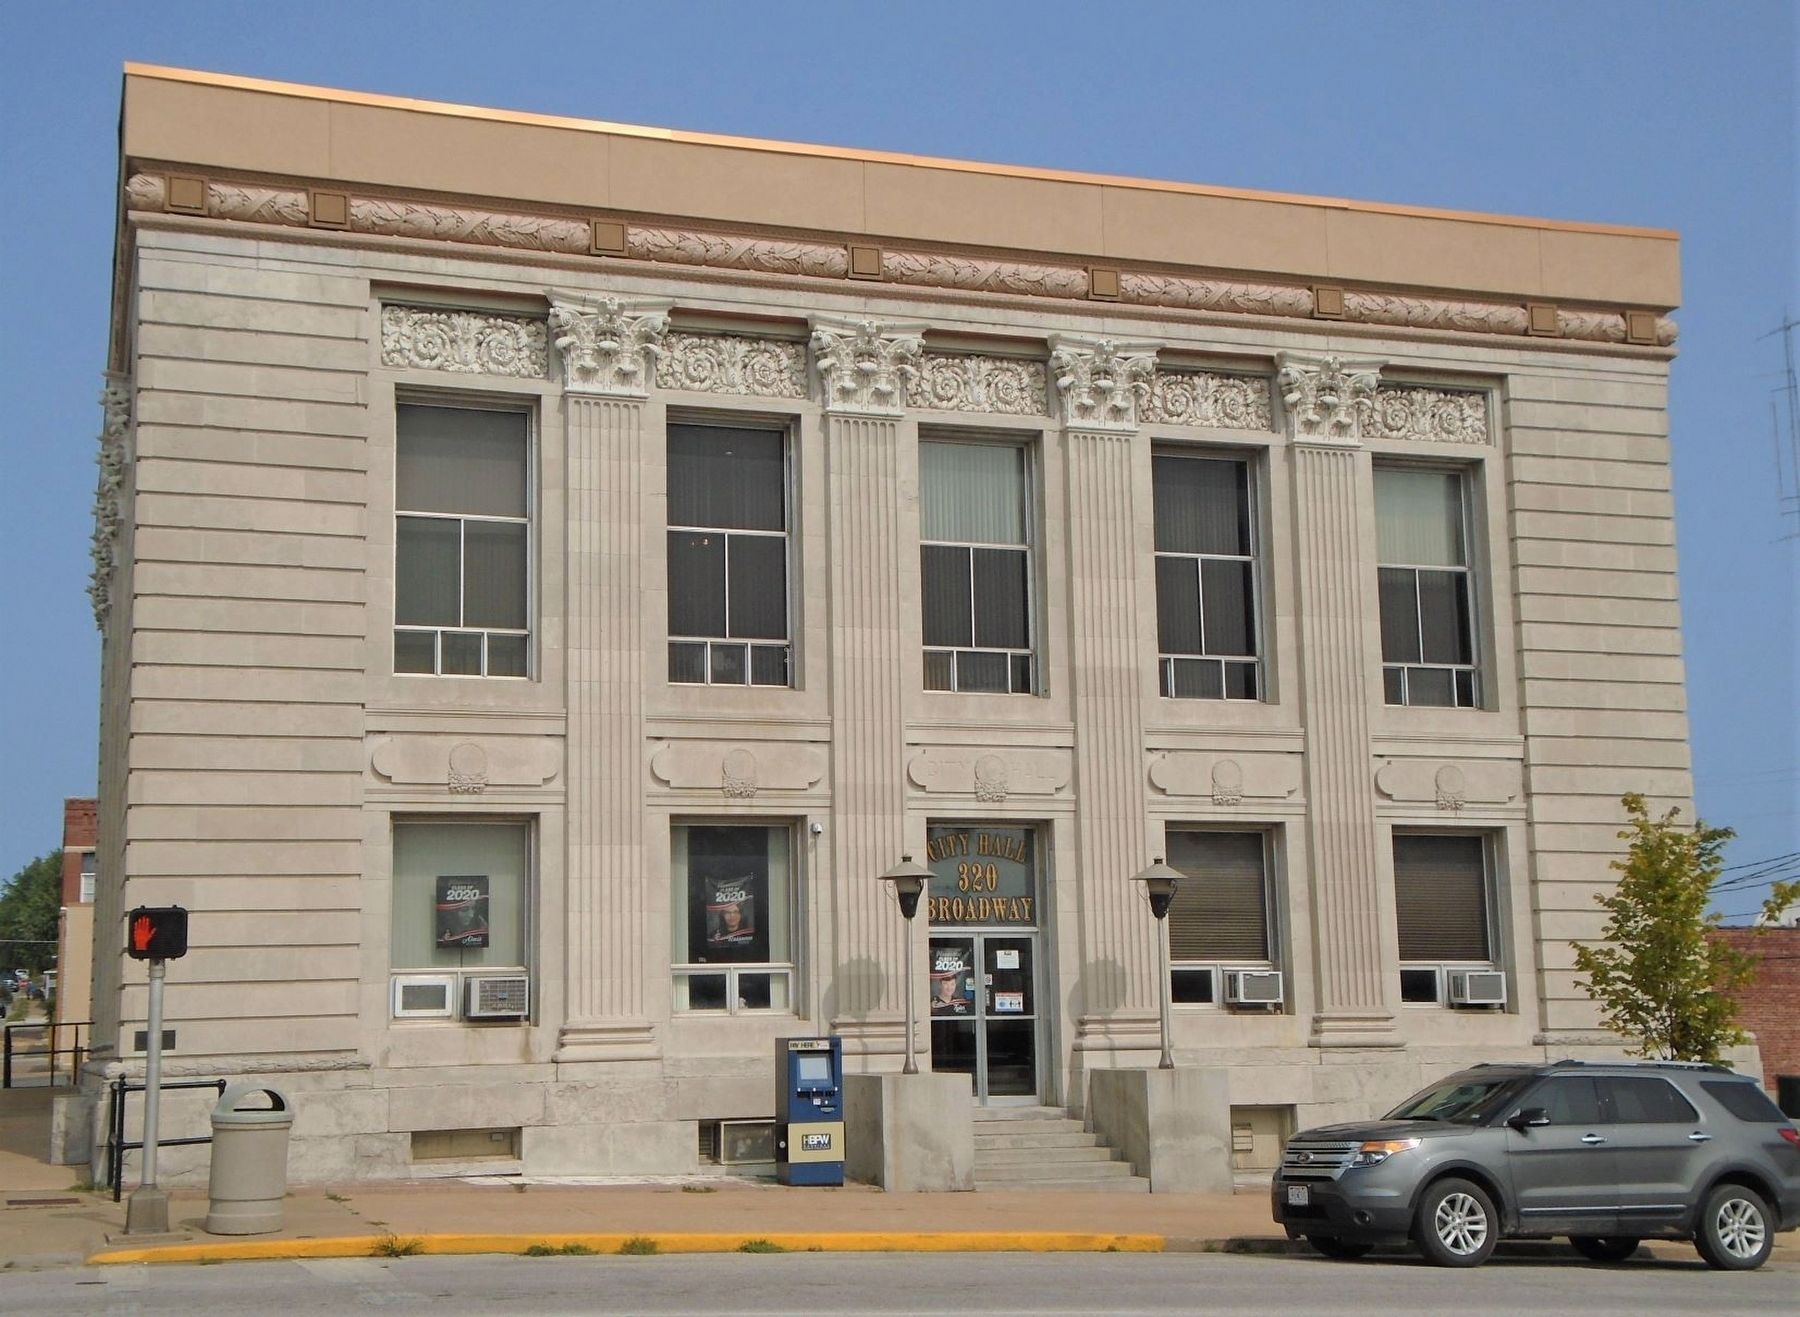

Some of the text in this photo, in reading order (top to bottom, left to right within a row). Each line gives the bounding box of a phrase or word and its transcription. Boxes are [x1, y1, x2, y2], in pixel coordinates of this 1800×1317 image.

[928, 833, 1027, 864] CITY HALL
[958, 862, 998, 893] 320
[446, 889, 480, 901] 2020
[715, 890, 746, 902] 2020
[928, 896, 1033, 922] BROADWAY
[935, 960, 963, 970] 2020
[803, 1134, 830, 1144] HBPW
